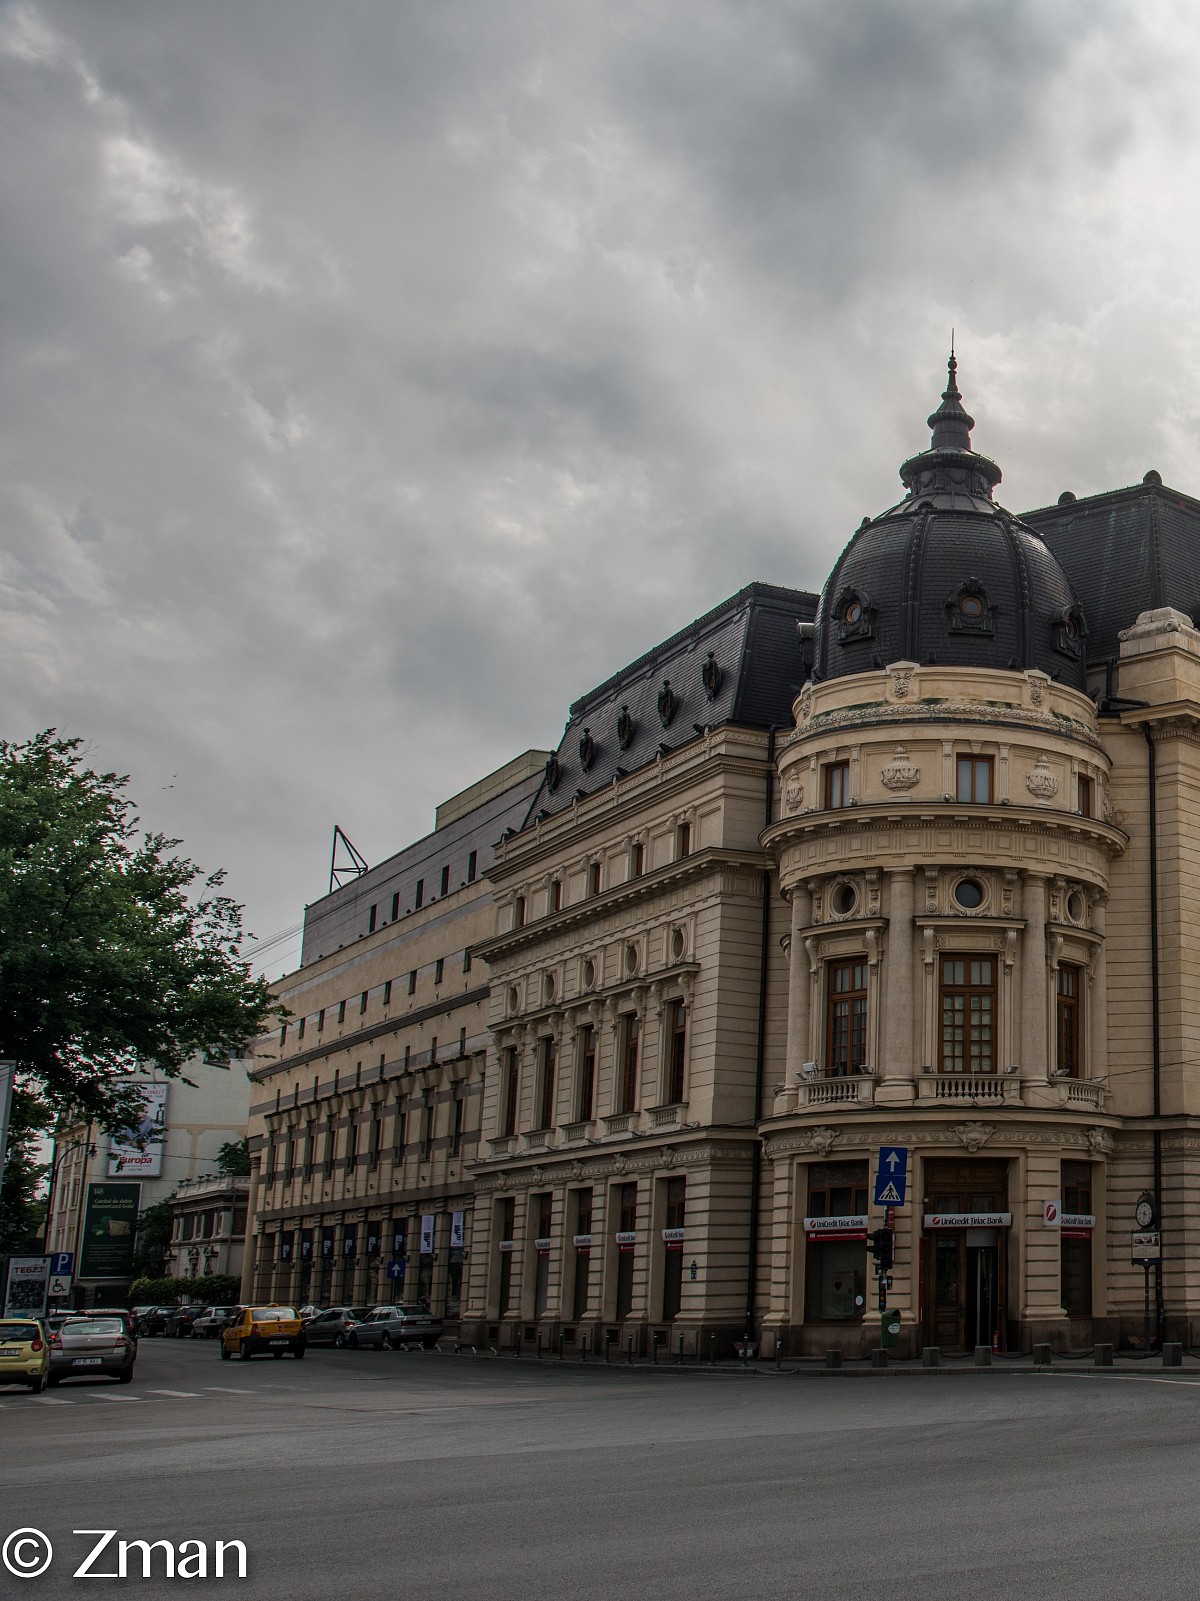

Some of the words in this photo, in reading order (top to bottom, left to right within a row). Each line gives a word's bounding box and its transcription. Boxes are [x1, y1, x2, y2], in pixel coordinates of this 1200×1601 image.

[119, 1156, 153, 1165] Europa
[816, 1219, 838, 1228] UniCredit
[851, 1218, 864, 1226] Bank
[941, 1216, 969, 1225] UniCredit
[986, 1216, 1003, 1224] Bank
[57, 1253, 69, 1271] P
